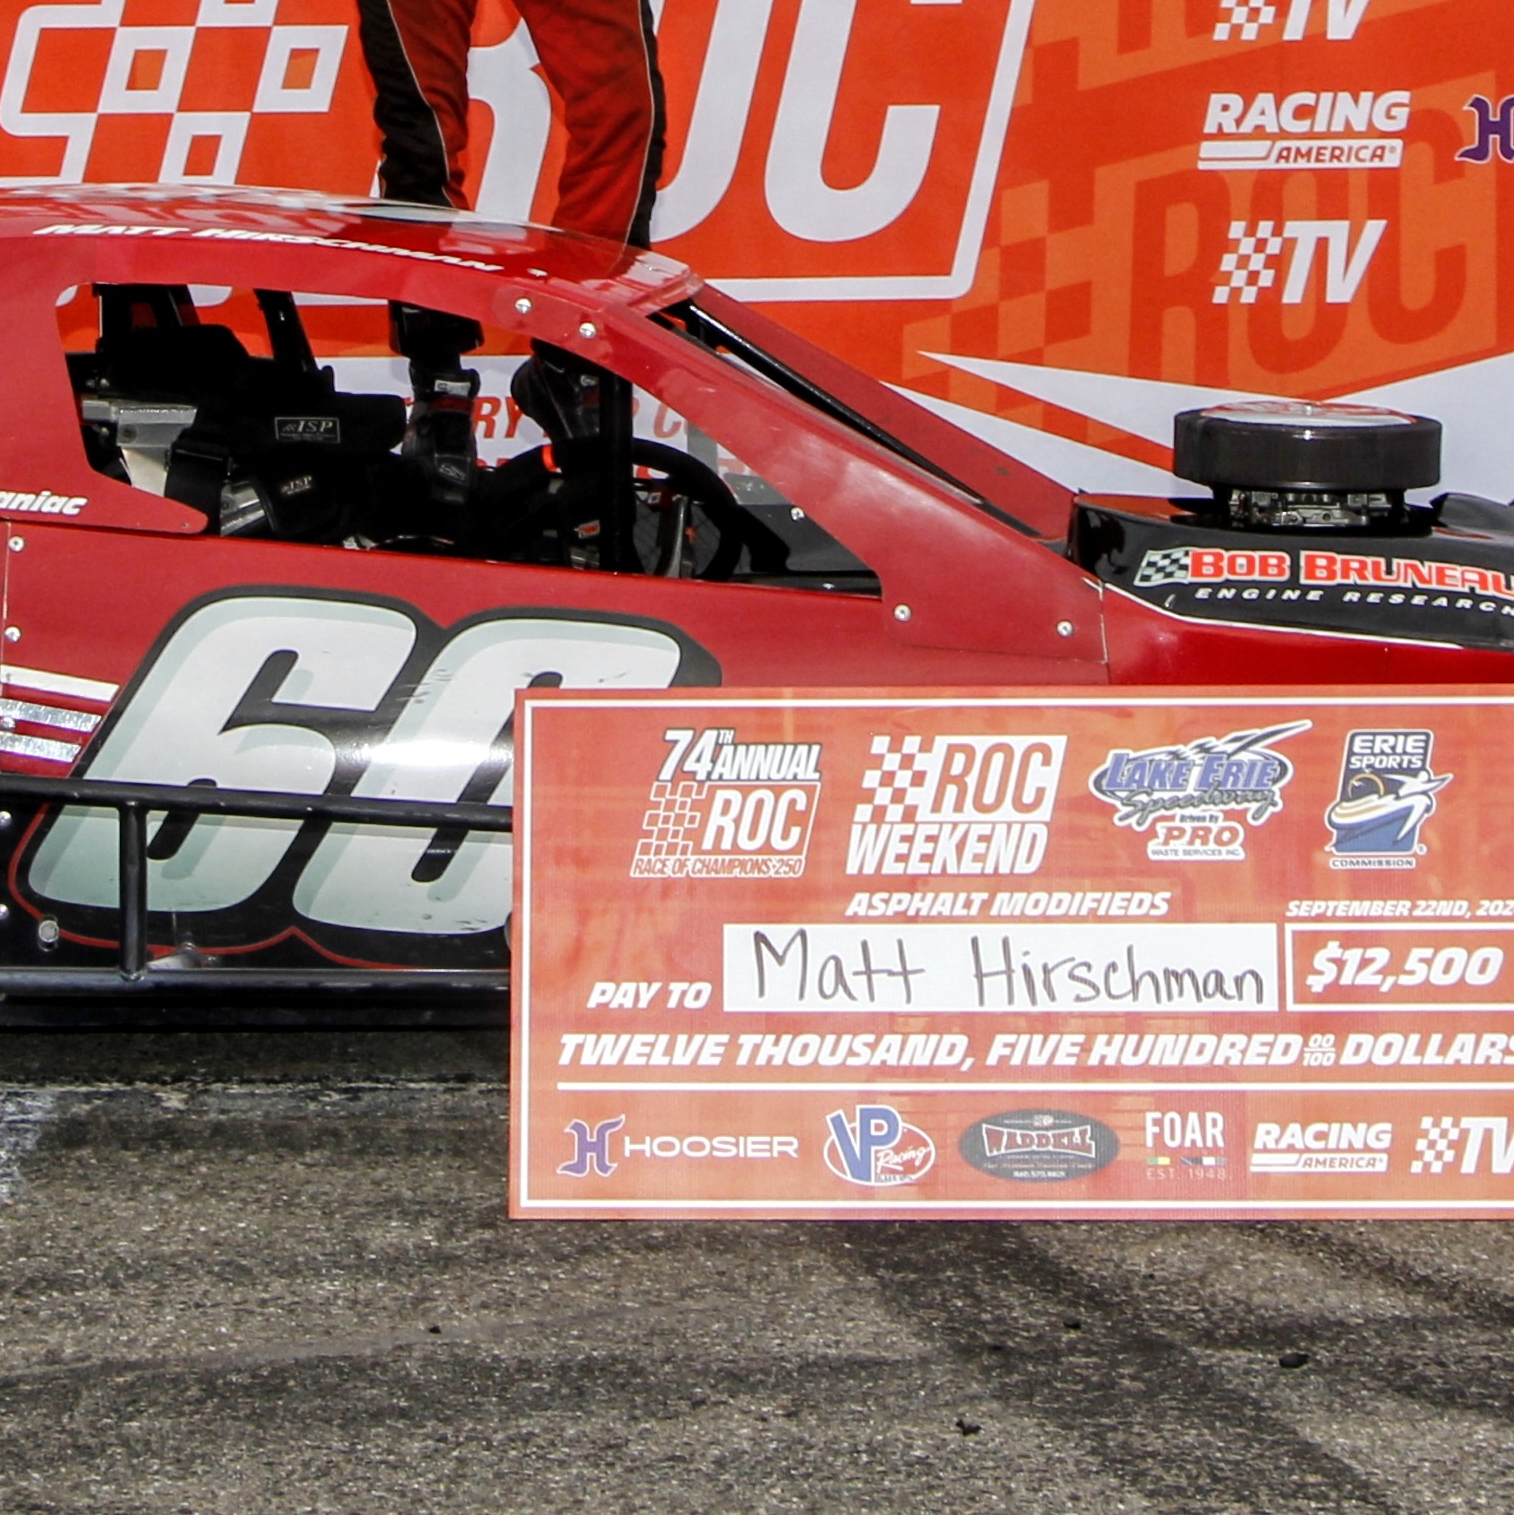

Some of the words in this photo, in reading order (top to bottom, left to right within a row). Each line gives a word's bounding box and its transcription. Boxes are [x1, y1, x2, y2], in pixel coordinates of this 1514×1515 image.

[32, 224, 190, 236] MATT
[191, 227, 504, 272] HIRSCHMAN
[1195, 587, 1325, 602] ENGINE
[1352, 734, 1426, 754] ERIE
[710, 744, 822, 781] ANNUAL
[1102, 752, 1194, 792] LAKE
[1194, 753, 1283, 792] ERIE
[1349, 755, 1424, 770] SPORTS
[930, 742, 1053, 814] ROC
[1116, 782, 1280, 827] Speedway
[701, 789, 808, 852] ROC
[847, 823, 1049, 875] WEEKEND
[1160, 826, 1240, 847] PRO
[1151, 848, 1180, 856] WASTE
[1182, 848, 1223, 856] SERVICES
[1332, 858, 1416, 868] COMMISSION
[634, 857, 670, 876] RACE
[672, 857, 690, 876] OF
[692, 857, 771, 876] CHAMPIONS
[846, 891, 988, 917] ASPHALT
[991, 891, 1172, 917] MODIFIEDS
[1286, 900, 1412, 917] SEPTEMBER
[1415, 900, 1471, 920] 22ND,
[753, 928, 926, 1004] Matt
[970, 936, 1264, 1006] Hirschman
[1306, 941, 1504, 993] $12,500
[587, 982, 659, 1008] PAY
[667, 982, 712, 1008] TO
[557, 1033, 727, 1066] TWELVE
[735, 1033, 975, 1071] THOUSAND,
[985, 1033, 1084, 1066] FIVE
[1087, 1033, 1304, 1066] HUNDRED
[1145, 1112, 1225, 1148] FOAR
[1253, 1123, 1393, 1149] RACING
[624, 1136, 799, 1158] HOOSIER
[826, 1105, 902, 1185] VP
[876, 1147, 932, 1173] Racing
